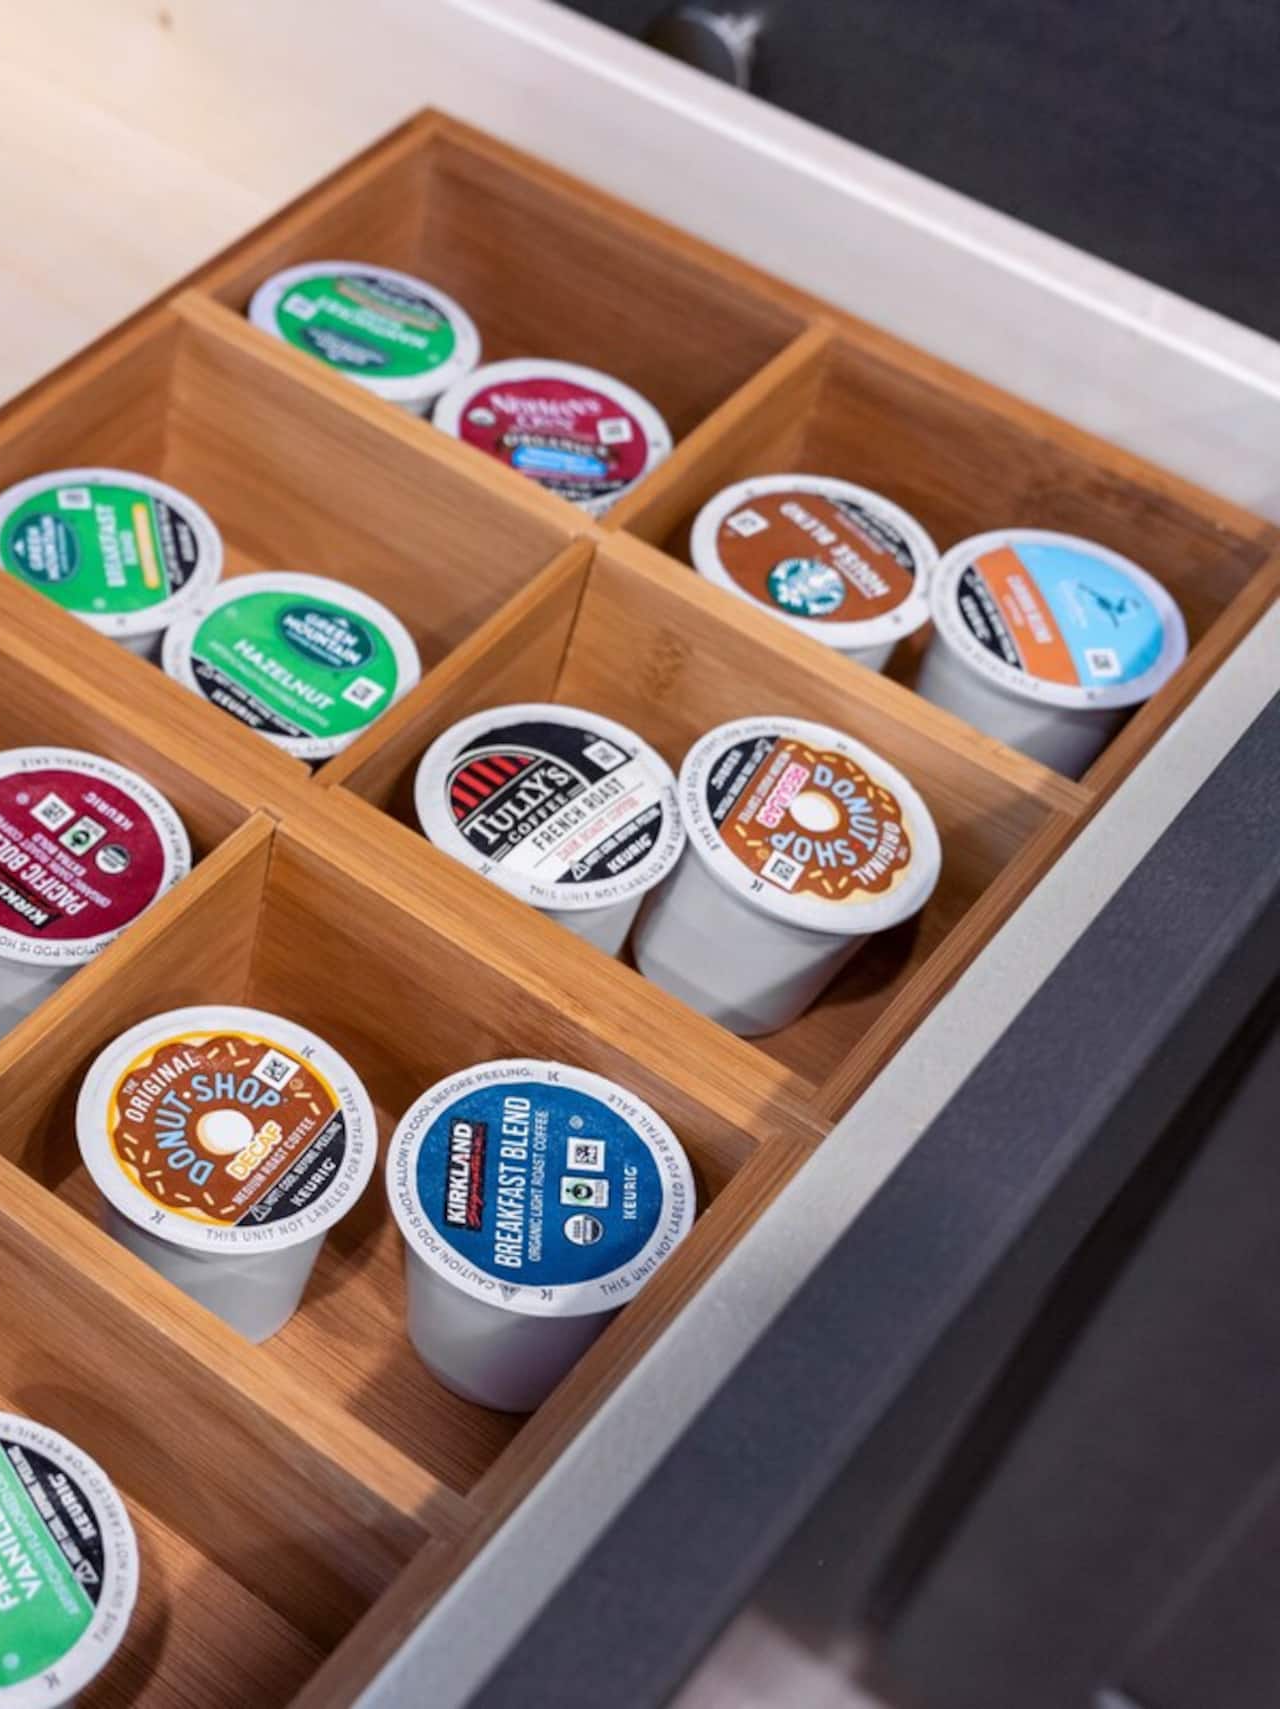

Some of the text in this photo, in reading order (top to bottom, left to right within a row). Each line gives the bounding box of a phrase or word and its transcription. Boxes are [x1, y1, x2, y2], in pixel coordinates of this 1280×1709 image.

[304, 612, 359, 647] GREEN
[233, 639, 336, 710] HAZELNUT
[82, 791, 134, 831] KEURIG
[463, 765, 570, 845] TULLY'S
[508, 793, 569, 844] COFFEE
[532, 803, 587, 850] FRENCH
[582, 777, 625, 811] ROAST
[771, 764, 880, 868] DONUT SHOP
[606, 833, 652, 874] KEURIG
[852, 821, 901, 885] ORIGINAL
[20, 863, 89, 916] PACIFIC
[122, 1078, 140, 1095] THE
[124, 1050, 204, 1125] ORIGINAL
[154, 1071, 282, 1187] DONUT SHOP
[283, 1116, 316, 1151] COFFEE
[401, 1131, 415, 1146] TO
[409, 1105, 434, 1129] COOL
[224, 1119, 284, 1182] DECAF
[447, 1121, 474, 1224] KIRKLAND
[206, 1228, 238, 1242] THIS
[242, 1228, 276, 1242] UNIT
[278, 1216, 305, 1235] NOT
[306, 1181, 351, 1223] LABELED
[345, 1157, 360, 1181] FOR
[289, 1157, 337, 1207] KEURIG
[494, 1095, 531, 1270] BREAKFAST BLEND
[528, 1109, 550, 1262] ORGANIC LIGHT ROAST COFFEE
[600, 1094, 685, 1297] THIS UNIT NOT LABELED FOR RETAIL SALE
[622, 1166, 638, 1220] KEURIG
[409, 1216, 421, 1230] IS
[417, 1230, 440, 1253] POD
[440, 1249, 496, 1290] CAUTION:
[47, 1473, 98, 1540] KEURIG
